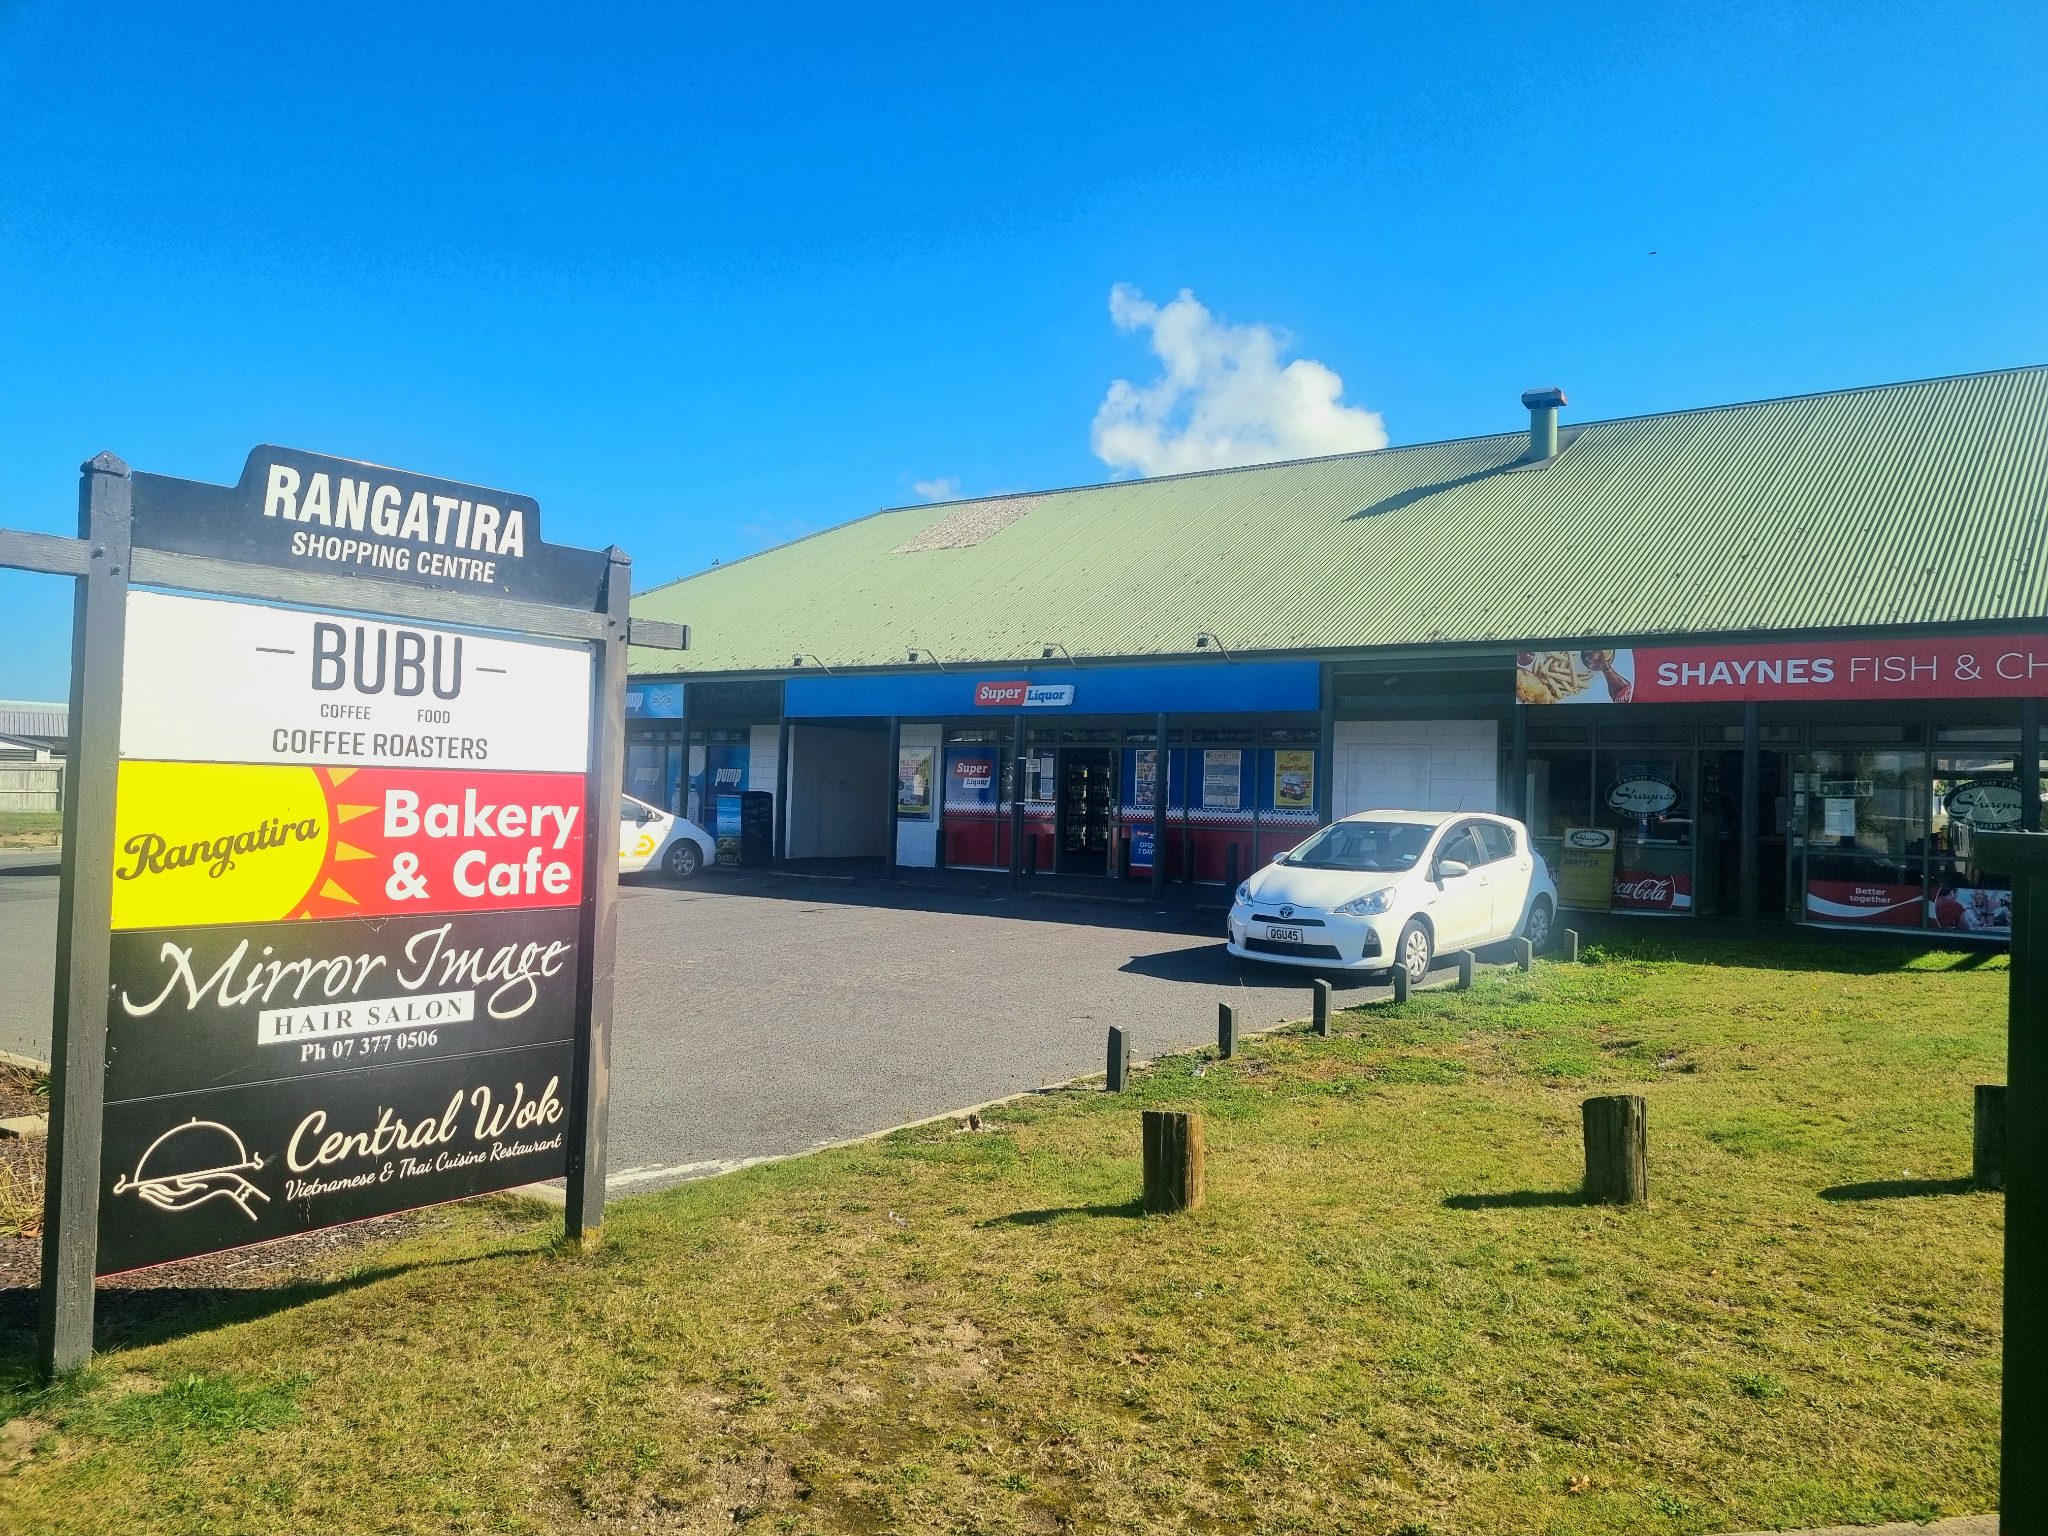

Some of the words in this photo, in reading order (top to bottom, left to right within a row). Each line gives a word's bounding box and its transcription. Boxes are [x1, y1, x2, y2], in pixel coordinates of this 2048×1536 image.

[263, 463, 525, 558] RANGATIRA
[291, 531, 411, 571] SHOPPING
[417, 551, 496, 584] CENTRE
[311, 622, 463, 700] BUBU
[1657, 658, 1834, 686] SHAYNES
[1850, 654, 1937, 683] FISH
[1954, 654, 1983, 680] &
[1996, 652, 2048, 679] CH
[980, 685, 1022, 702] Super
[1027, 689, 1065, 702] Liquor
[320, 703, 371, 720] COFFEE
[417, 709, 451, 724] FOOD
[272, 729, 365, 757] COFFEE
[372, 733, 488, 760] ROASTERS
[634, 767, 660, 784] pump
[714, 768, 742, 787] pump
[956, 762, 988, 775] Super
[966, 778, 988, 787] Liquor
[383, 789, 579, 849] Bakery
[116, 815, 320, 880] Rangatira
[385, 854, 430, 900] &
[453, 850, 572, 898] Cafe
[1612, 878, 1671, 901] oca-Cola
[1855, 887, 1886, 895] Better
[1849, 894, 1892, 904] together
[1270, 928, 1298, 941] QGU45
[122, 938, 386, 1016] Mirror
[396, 923, 570, 1020] Image
[274, 1009, 353, 1037] HAIR
[367, 998, 464, 1025] SALON
[300, 1040, 327, 1062] Ph
[332, 1037, 355, 1059] 07
[359, 1034, 392, 1055] 377
[397, 1029, 438, 1051] 0506
[286, 1090, 463, 1173] Central
[471, 1075, 563, 1138] Wok
[286, 1173, 375, 1201] Vietnamese
[380, 1163, 395, 1183] &
[399, 1156, 433, 1178] Thai
[436, 1150, 487, 1173] Cuisine
[490, 1133, 562, 1162] Restaurant
